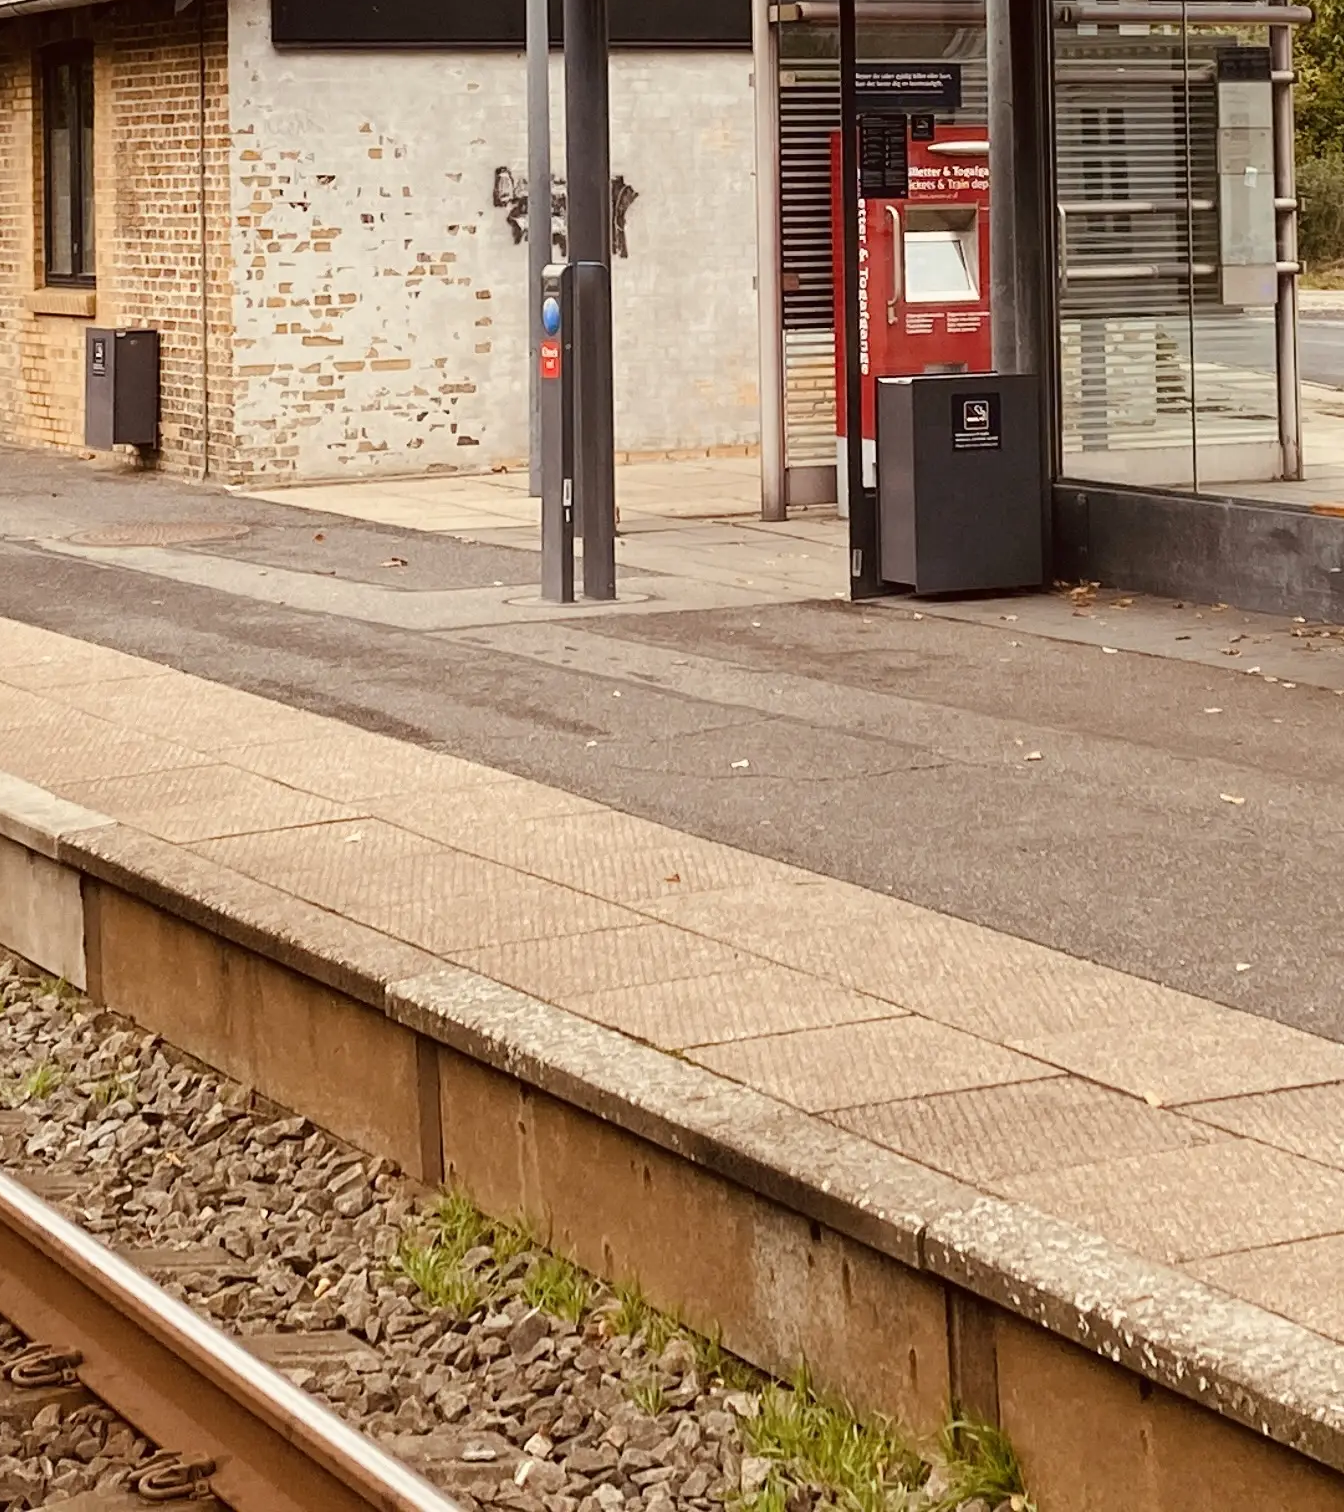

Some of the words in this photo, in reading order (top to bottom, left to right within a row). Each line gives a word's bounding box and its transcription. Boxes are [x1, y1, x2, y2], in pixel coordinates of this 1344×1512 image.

[908, 179, 936, 190] ickets
[947, 178, 970, 190] Train
[971, 179, 989, 191] dep
[952, 165, 989, 178] Togafga
[857, 198, 867, 244] etter
[858, 266, 870, 376] Togafgange
